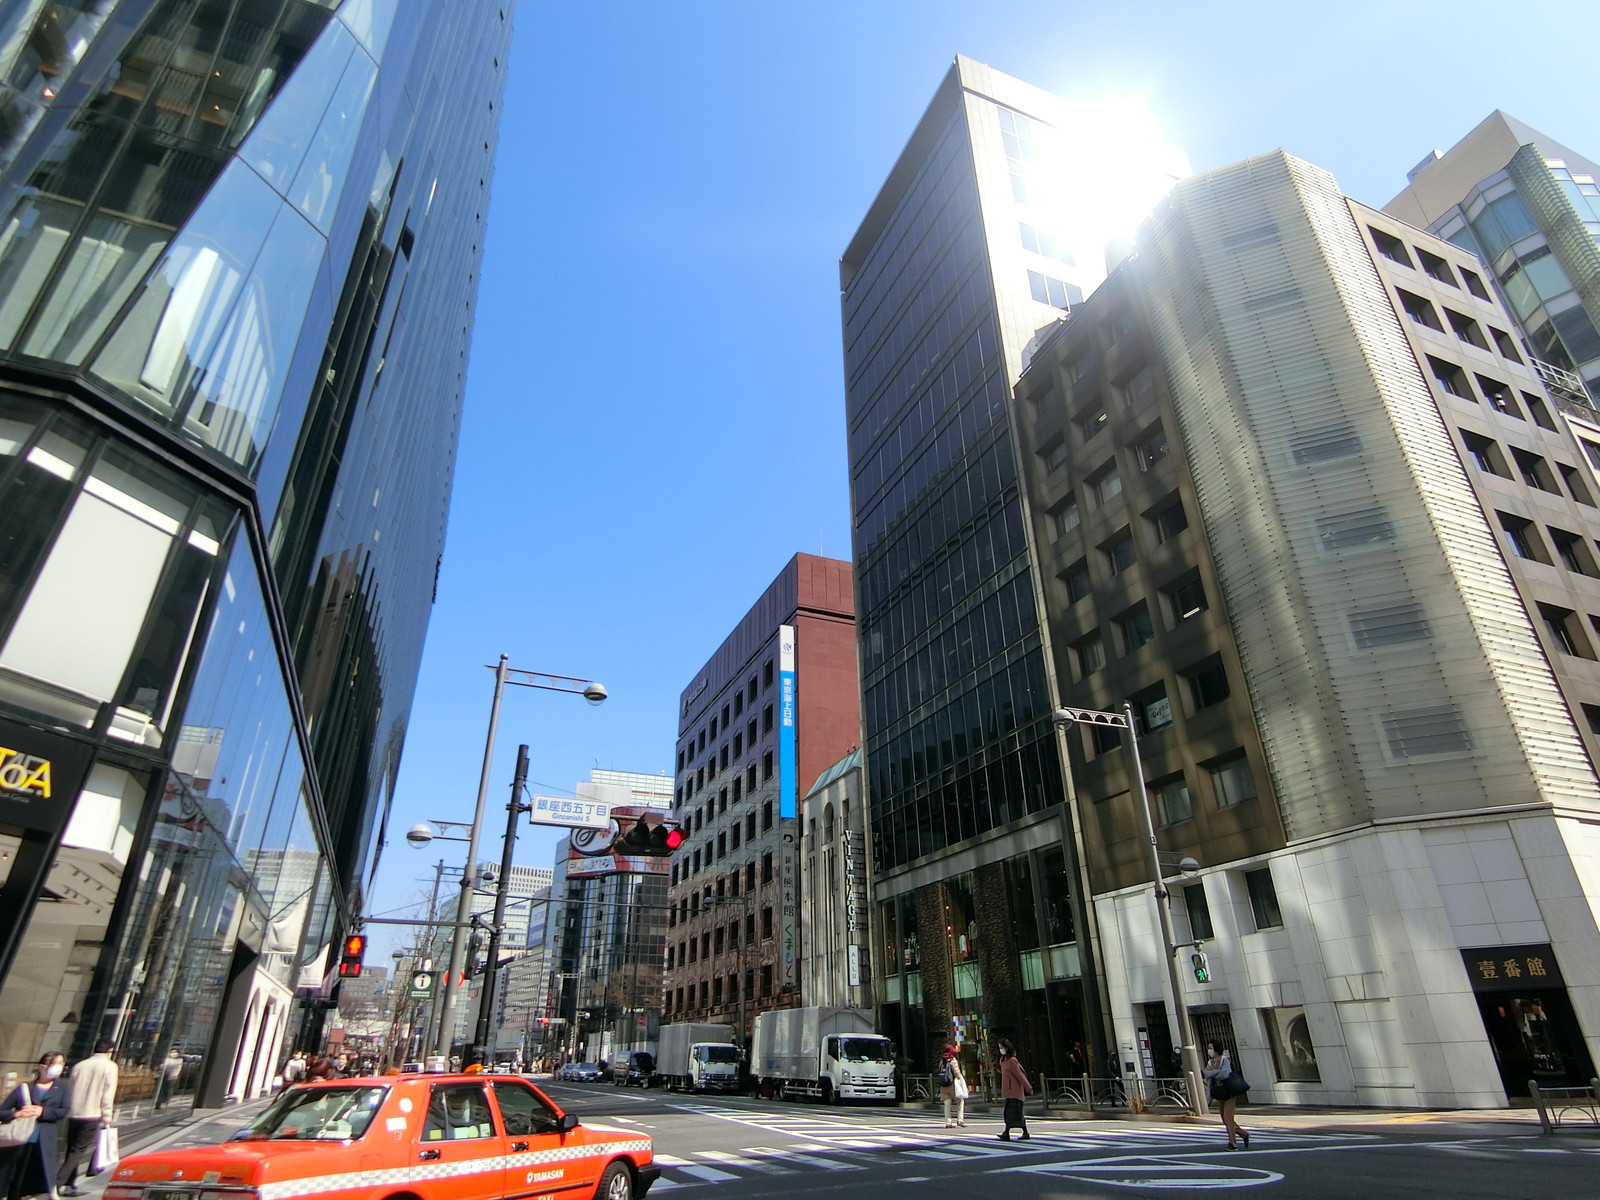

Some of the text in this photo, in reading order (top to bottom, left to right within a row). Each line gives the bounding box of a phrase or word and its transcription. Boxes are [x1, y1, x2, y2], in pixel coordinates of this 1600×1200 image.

[783, 678, 792, 726] 東京海上日動
[537, 799, 606, 816] 銀座西五丁目
[552, 812, 584, 821] Ginzanishi
[845, 830, 856, 931] VINTAGE
[784, 923, 794, 979] くまもと
[533, 1168, 564, 1182] YAMASAN
